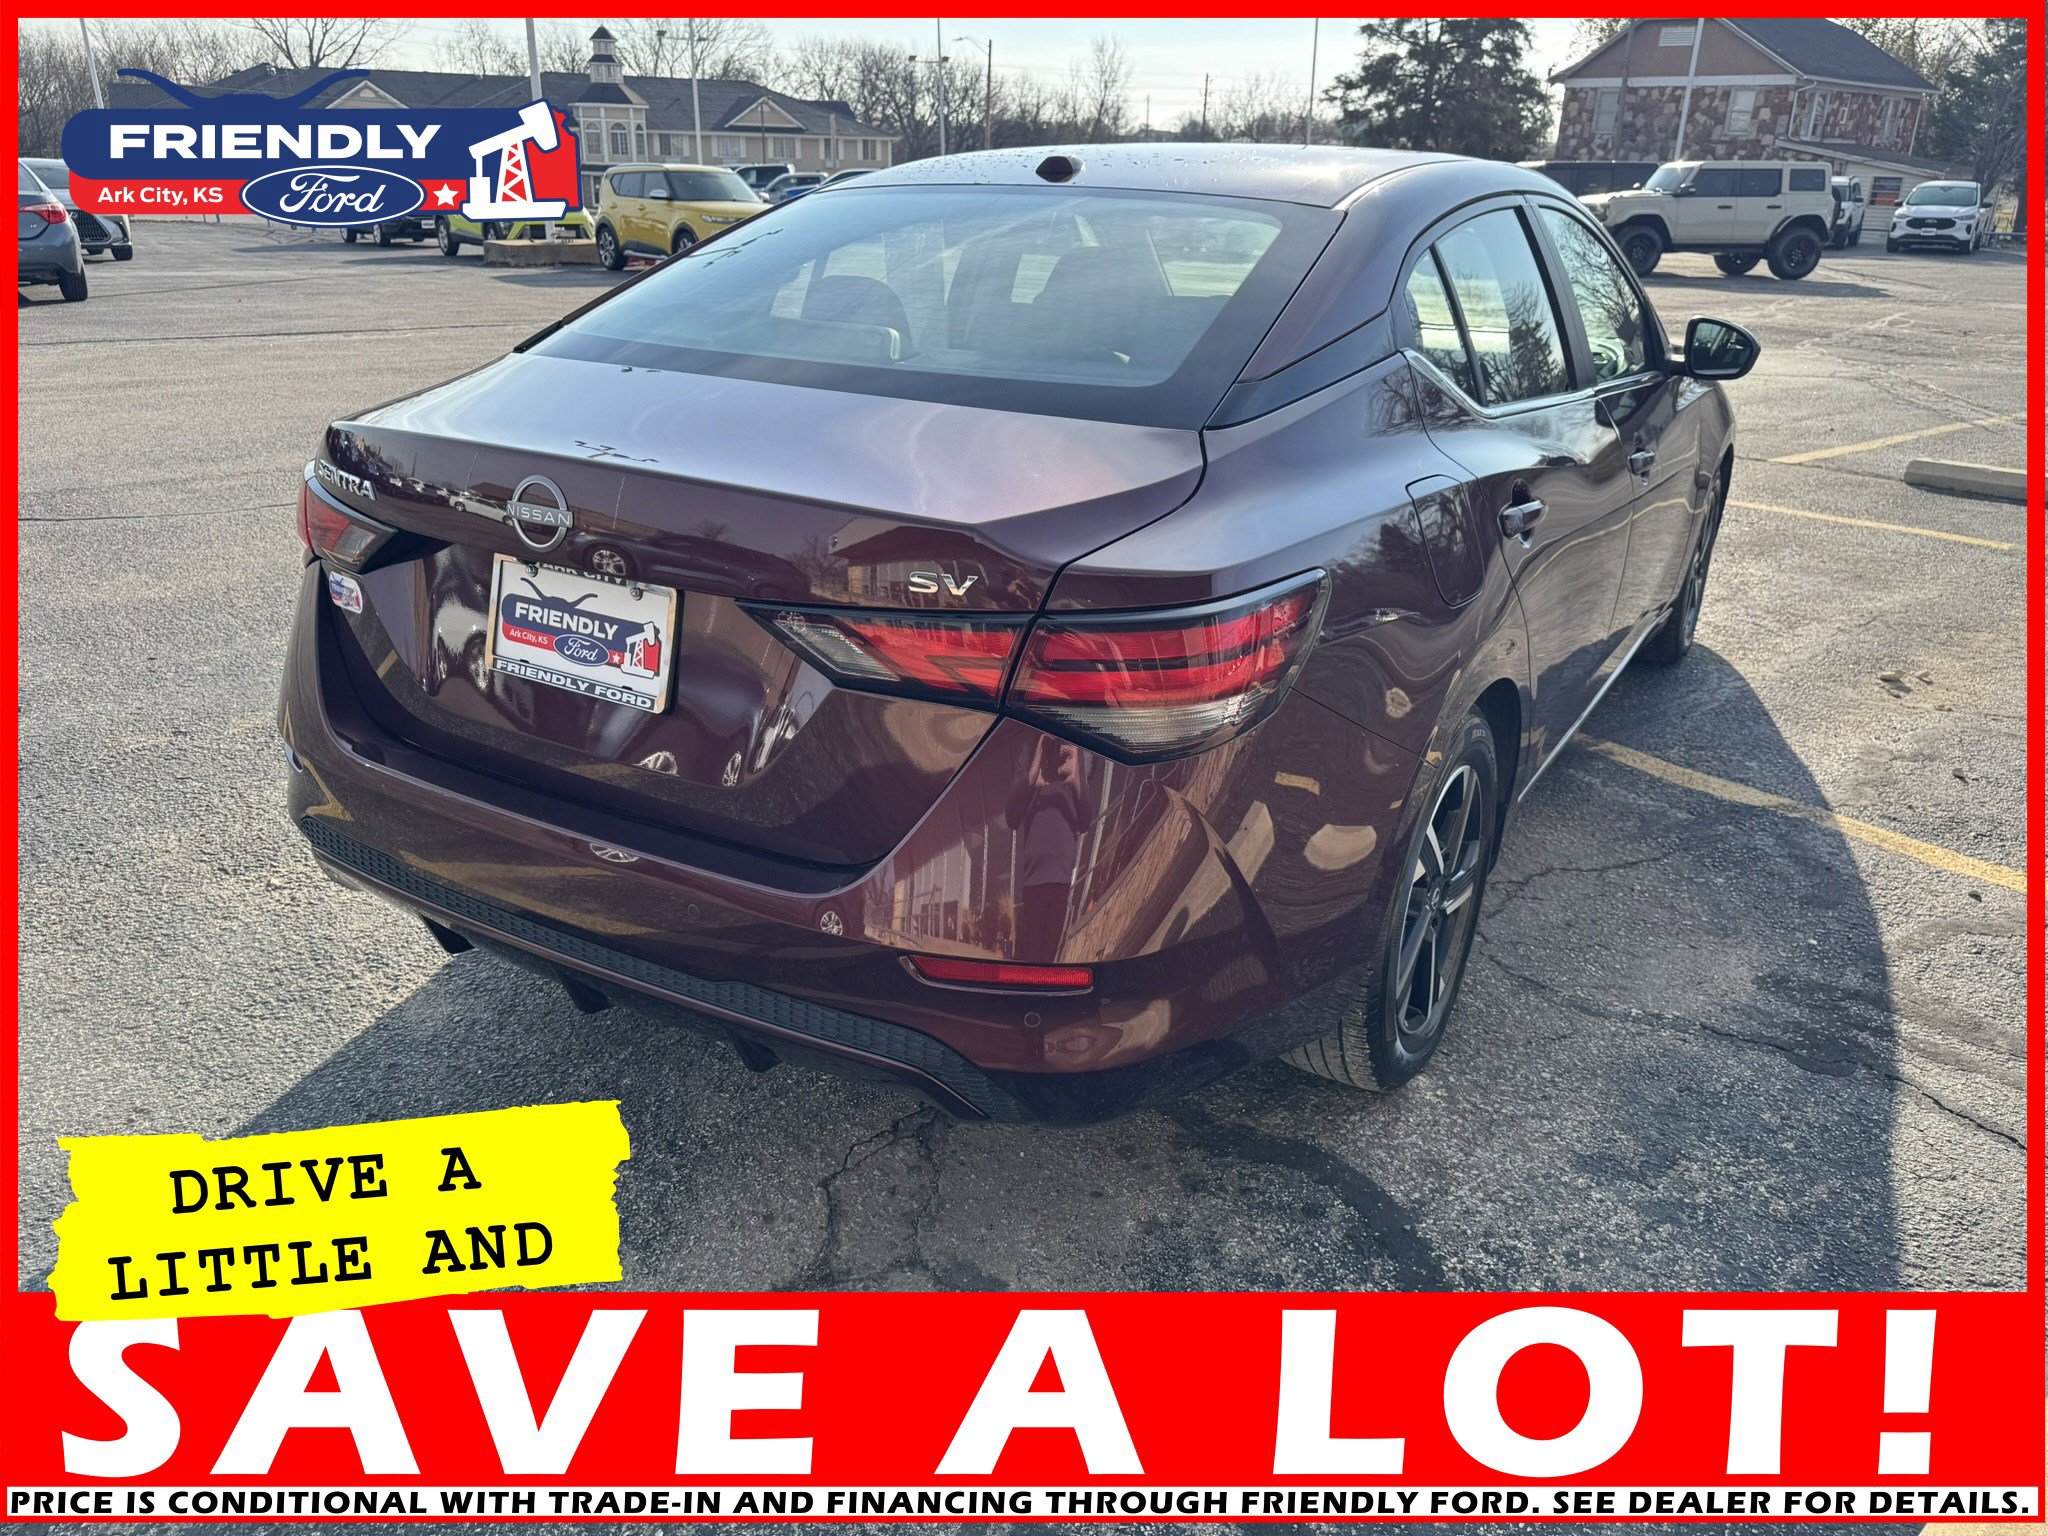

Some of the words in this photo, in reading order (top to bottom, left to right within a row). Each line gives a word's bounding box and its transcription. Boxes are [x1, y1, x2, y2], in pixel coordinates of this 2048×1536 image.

[317, 459, 378, 501] SENTRA
[507, 503, 570, 525] NISSAN
[908, 571, 979, 596] SV
[514, 601, 619, 641] FRIENDLY
[509, 628, 523, 640] Ark
[522, 631, 537, 643] City,
[537, 635, 549, 645] KS
[563, 637, 599, 662] Ford
[496, 660, 591, 691] FRIENDLY
[594, 686, 652, 708] FORD
